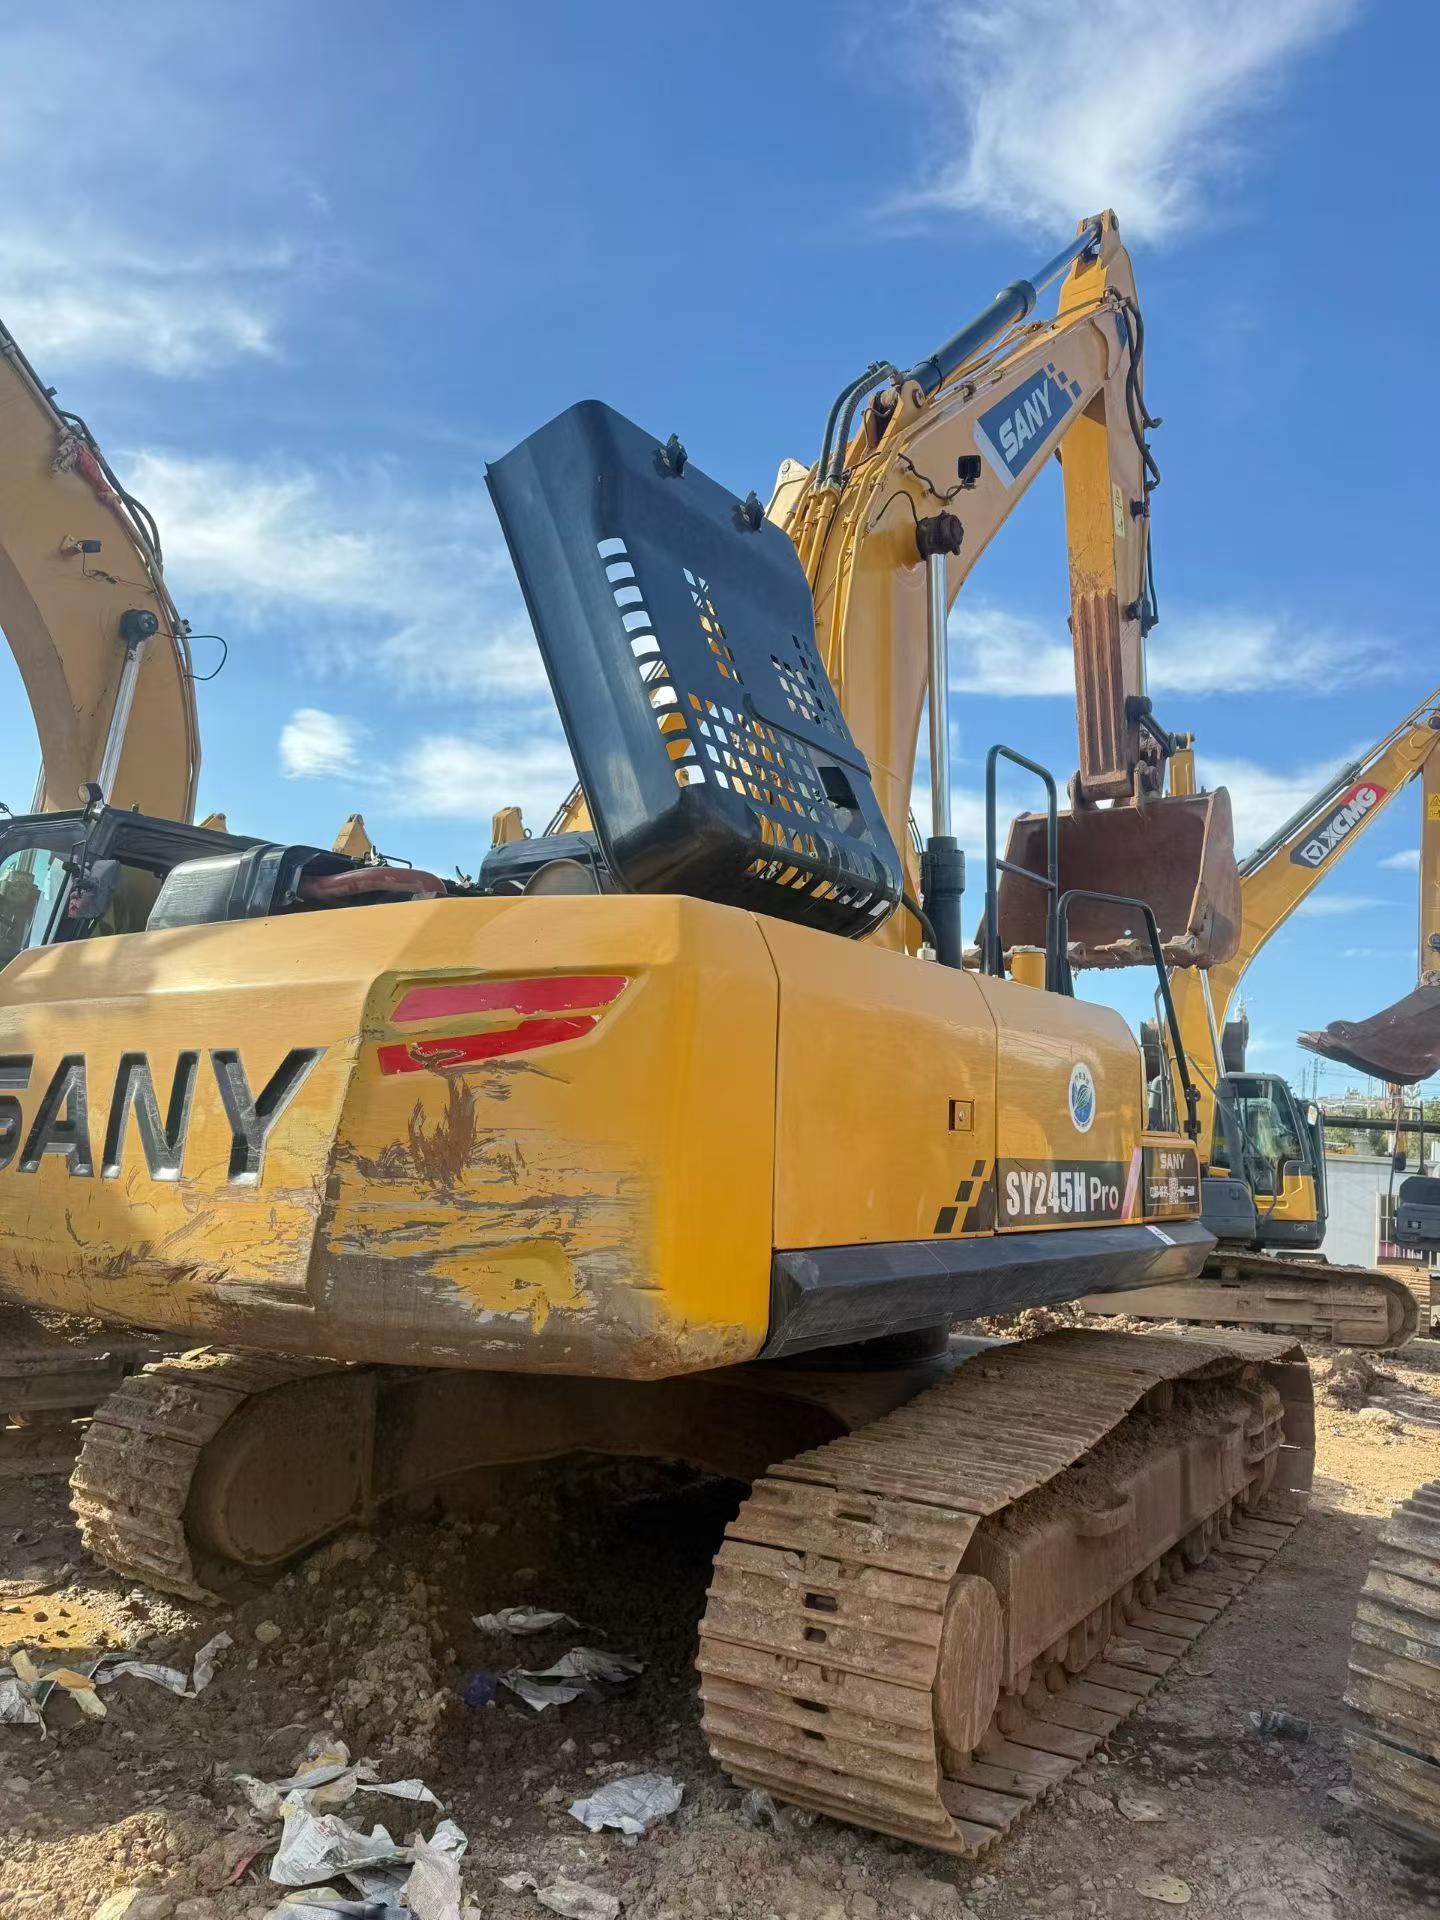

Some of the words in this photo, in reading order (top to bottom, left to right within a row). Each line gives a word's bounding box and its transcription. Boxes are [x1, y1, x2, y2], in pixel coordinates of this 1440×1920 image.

[999, 379, 1053, 463] SANY
[1318, 787, 1377, 850] XCMG
[1160, 1153, 1185, 1170] SANY
[1006, 1171, 1087, 1216] SY245H
[1090, 1177, 1119, 1212] Pro
